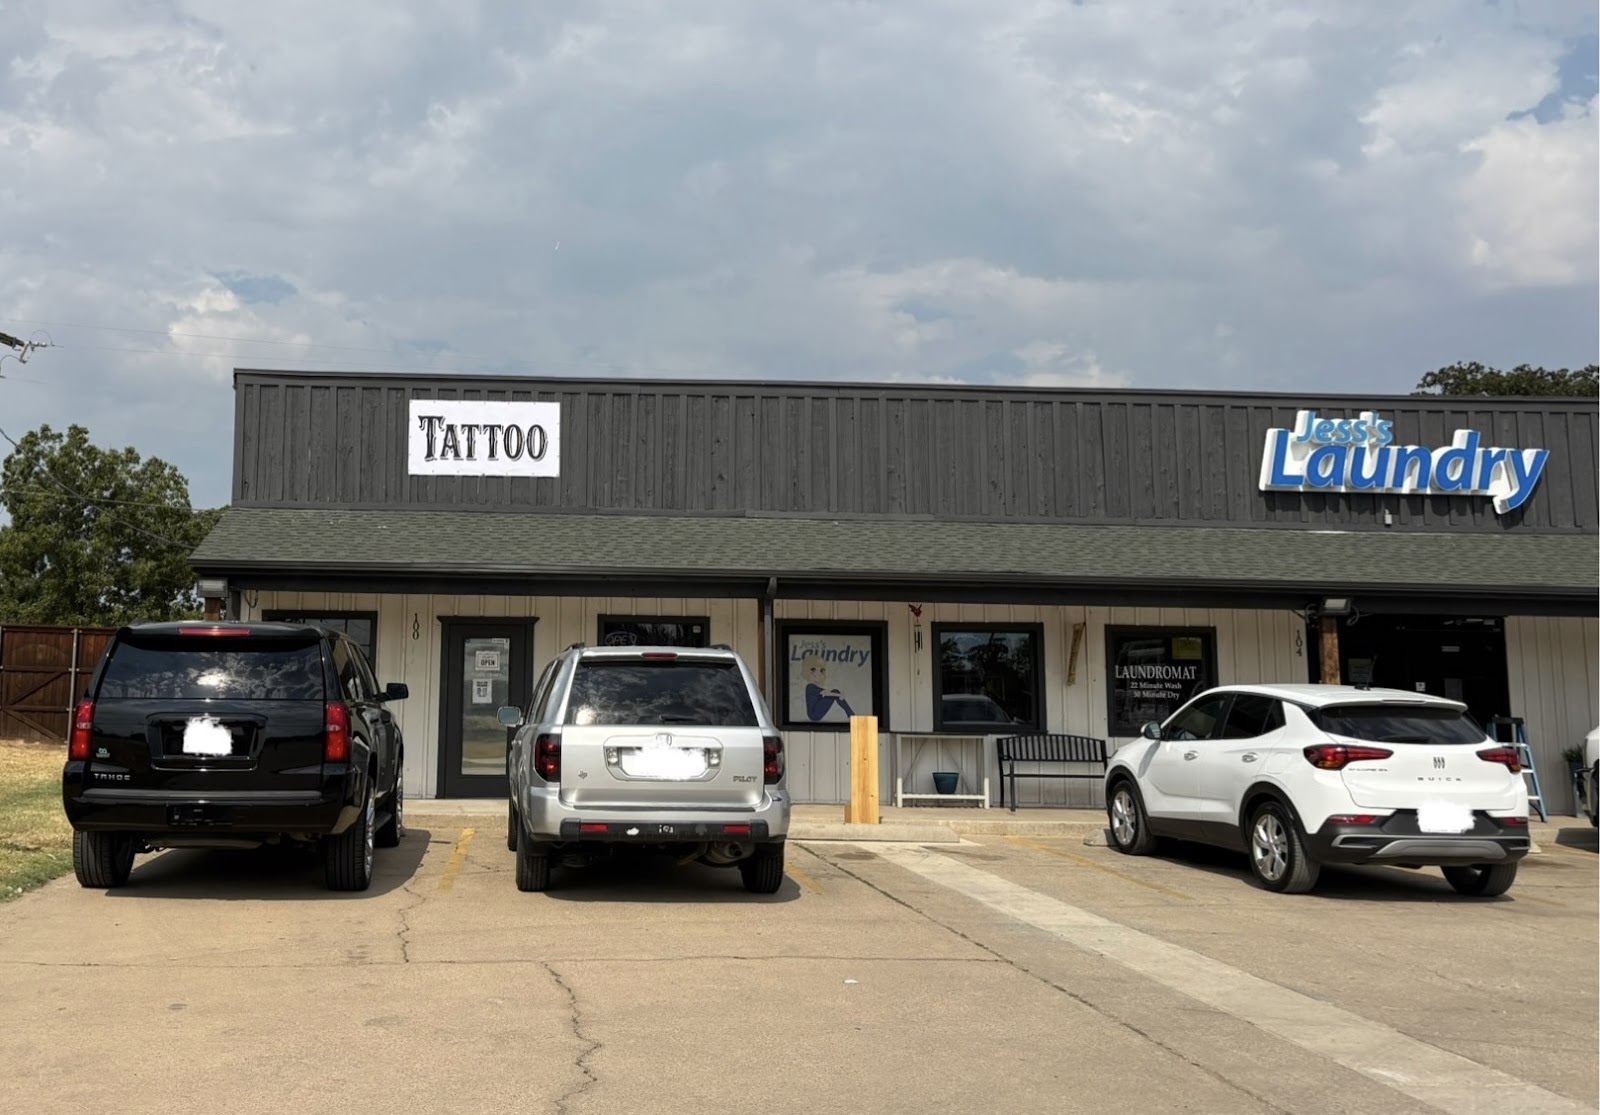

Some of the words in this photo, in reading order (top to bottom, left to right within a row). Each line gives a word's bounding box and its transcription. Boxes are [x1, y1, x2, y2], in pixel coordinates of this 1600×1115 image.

[1296, 411, 1393, 446] Jess's
[1262, 429, 1549, 512] Laundry
[412, 612, 420, 640] 100
[1115, 665, 1197, 679] LAUNDROMAT
[1168, 691, 1180, 700] Dry
[94, 773, 131, 781] TAHOE
